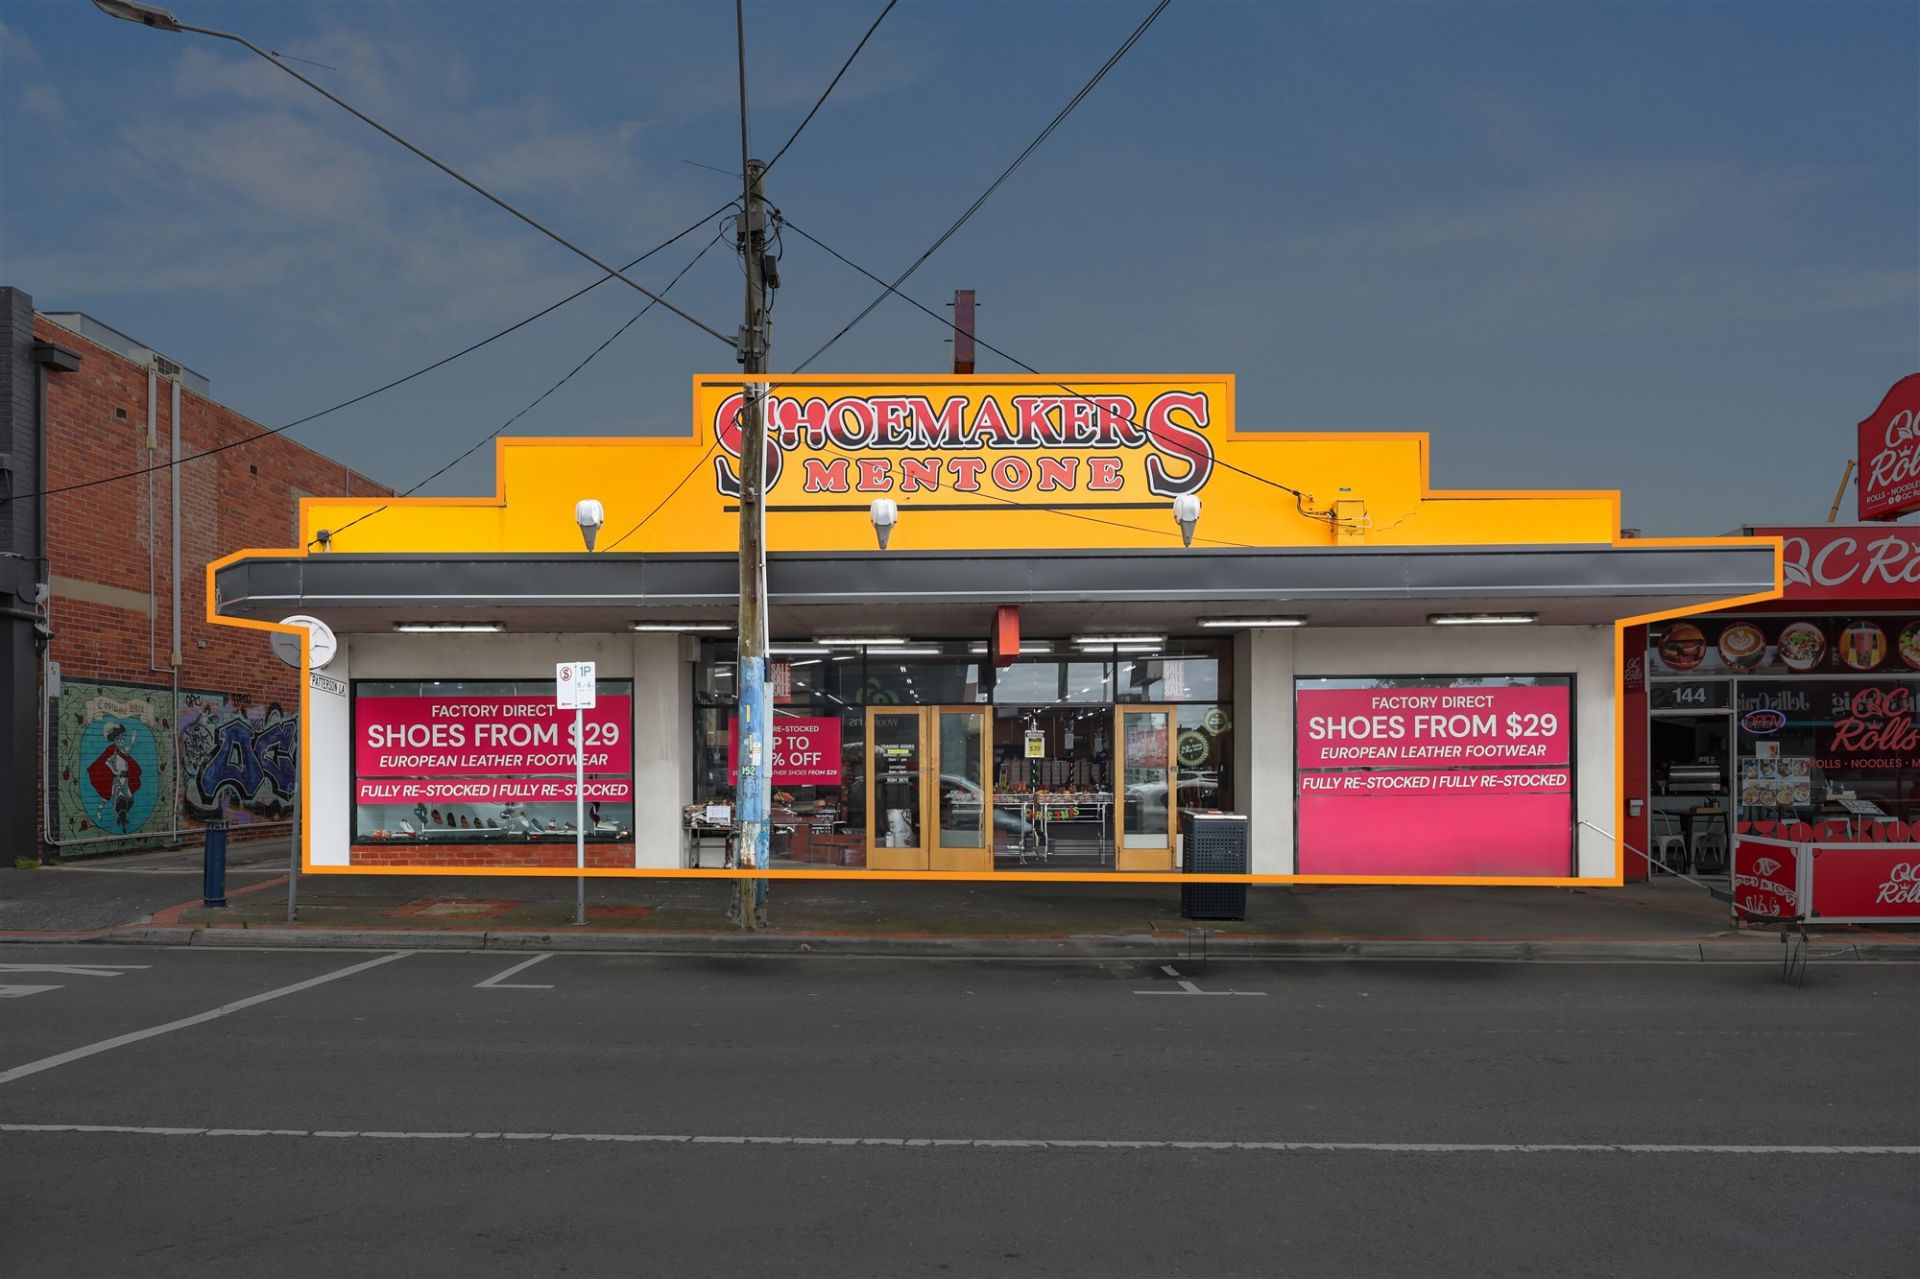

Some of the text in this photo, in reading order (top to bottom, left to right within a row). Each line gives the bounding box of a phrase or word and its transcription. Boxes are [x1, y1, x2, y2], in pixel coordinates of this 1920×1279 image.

[715, 392, 1214, 497] SHOEMAKERS
[803, 456, 1124, 493] MENTONE
[1866, 492, 1886, 504] ROLLS
[580, 666, 591, 677] 1P
[771, 663, 791, 674] SALE
[312, 675, 338, 692] PATTERSON
[771, 674, 791, 685] SALE
[1372, 695, 1494, 709] FACTORY DIRECT
[1672, 688, 1706, 703] 144
[1852, 688, 1909, 718] QC
[432, 704, 556, 717] FACTORY DIRECT
[1309, 711, 1558, 740] SHOES FROM $29
[368, 724, 466, 748] SHOES
[474, 722, 558, 747] FROM
[1830, 716, 1920, 752] Rolls
[786, 736, 809, 750] TO
[790, 752, 822, 766] OFF
[1320, 744, 1547, 760] EUROPEAN LEATHER FOOTWEAR
[379, 755, 458, 768] EUROPEAN
[460, 754, 522, 768] LEATHER
[1851, 758, 1902, 768] NOODLES
[1302, 774, 1567, 790] FULLY RE-STOCKED FULLY RE-STOCKED
[360, 784, 400, 797] FULLY
[402, 784, 490, 797] RE-STOCKED
[498, 784, 540, 797] FULLY
